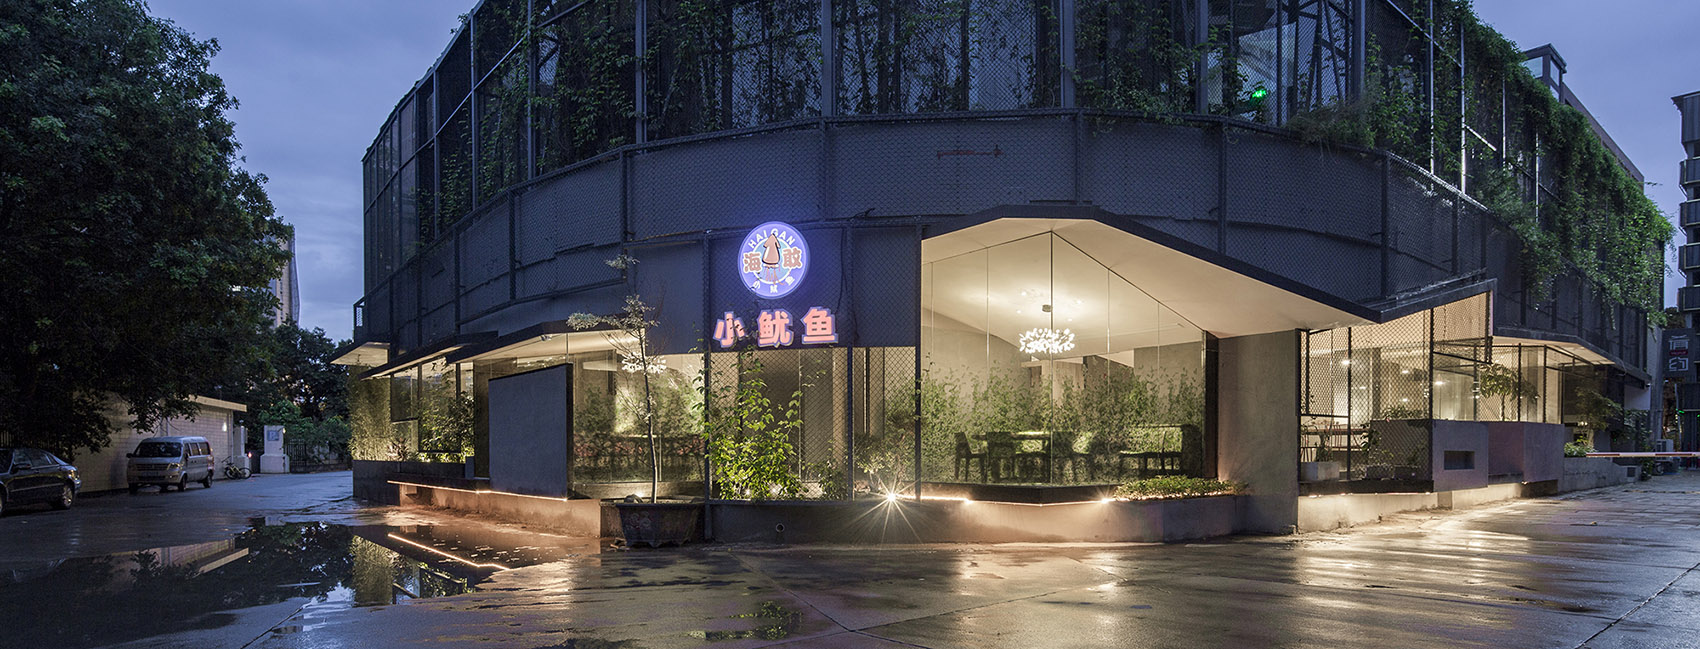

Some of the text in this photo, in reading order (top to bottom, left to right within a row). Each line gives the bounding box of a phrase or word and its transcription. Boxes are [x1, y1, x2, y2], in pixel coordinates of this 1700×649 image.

[748, 228, 796, 248] HAI GAN
[713, 306, 838, 348] 小鱿鱼
